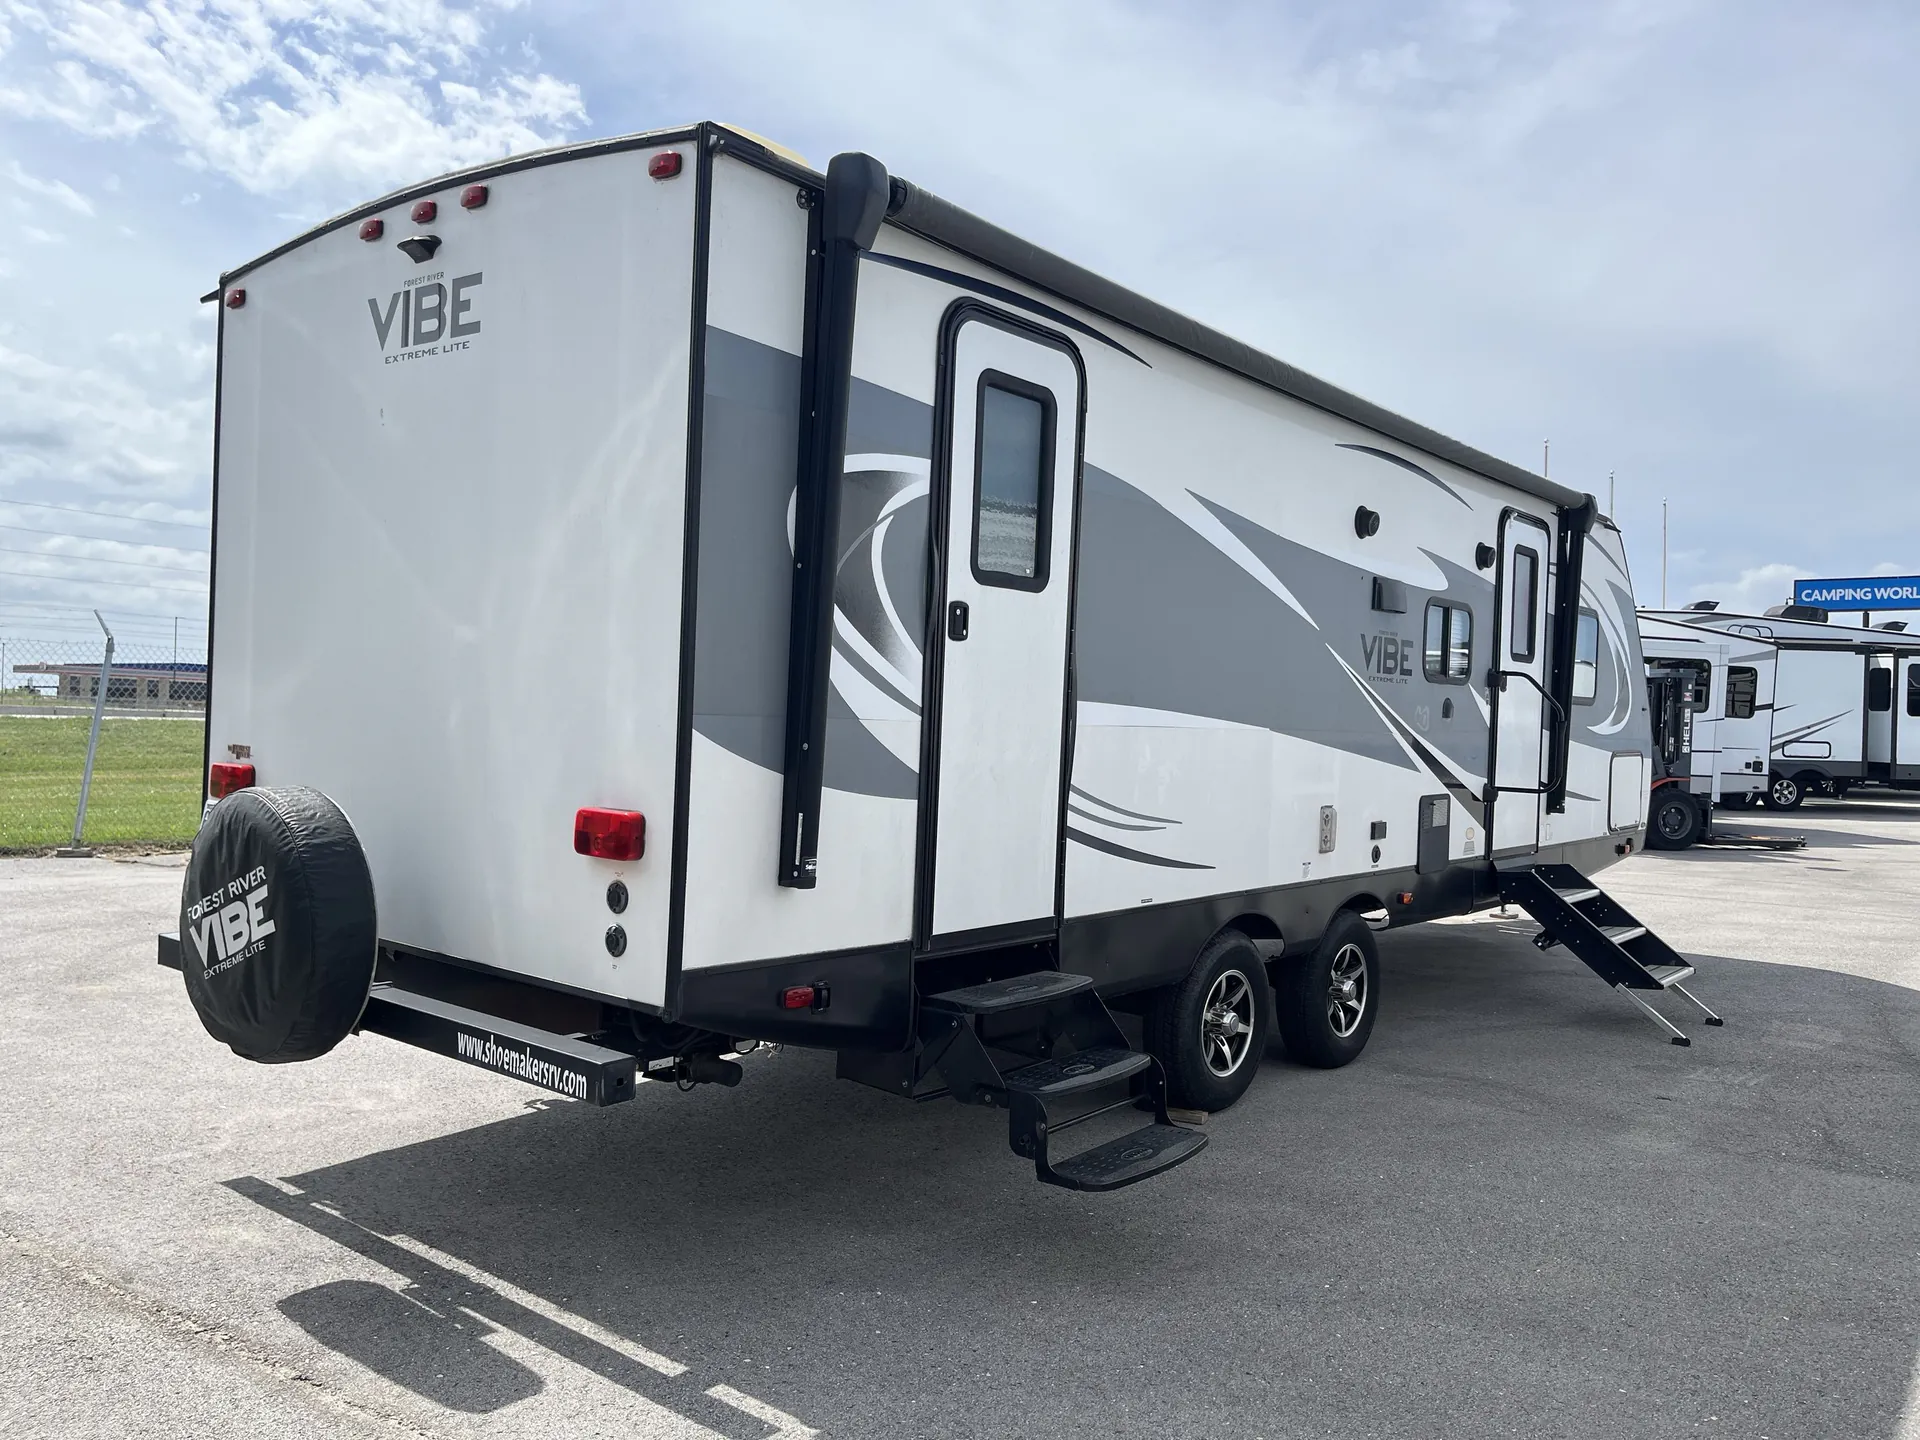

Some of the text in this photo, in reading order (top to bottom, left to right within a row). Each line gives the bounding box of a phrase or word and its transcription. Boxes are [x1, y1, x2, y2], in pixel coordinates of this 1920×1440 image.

[403, 271, 445, 288] FOREST RIVER
[367, 271, 483, 351] VIBE
[384, 341, 470, 364] EXTREME LITE
[1801, 586, 1920, 602] CAMPING WORL
[1360, 633, 1414, 677] VIBE
[187, 865, 267, 923] FOREST RIVER
[189, 884, 276, 968] VIBE
[203, 940, 266, 979] EXTREME LITE
[457, 1031, 587, 1099] www.shoemakersrv.com
